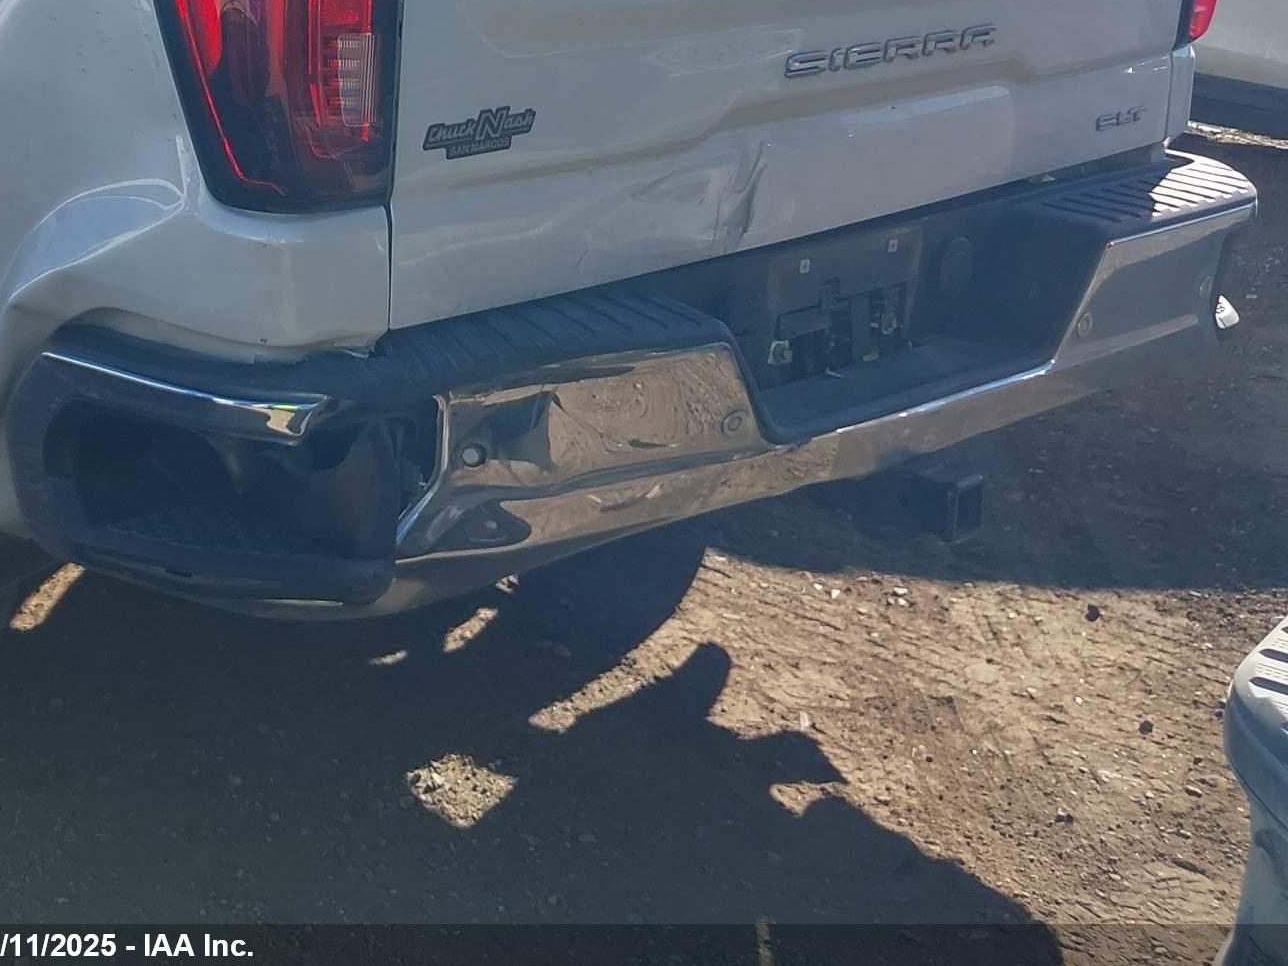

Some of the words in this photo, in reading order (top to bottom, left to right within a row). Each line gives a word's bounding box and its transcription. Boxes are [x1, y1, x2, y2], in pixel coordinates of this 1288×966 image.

[784, 23, 998, 78] SIERRA
[428, 118, 476, 142] Chuck
[475, 106, 535, 141] Nash
[1095, 105, 1147, 132] SLT
[449, 142, 470, 156] SAN
[471, 136, 510, 153] MARCOS
